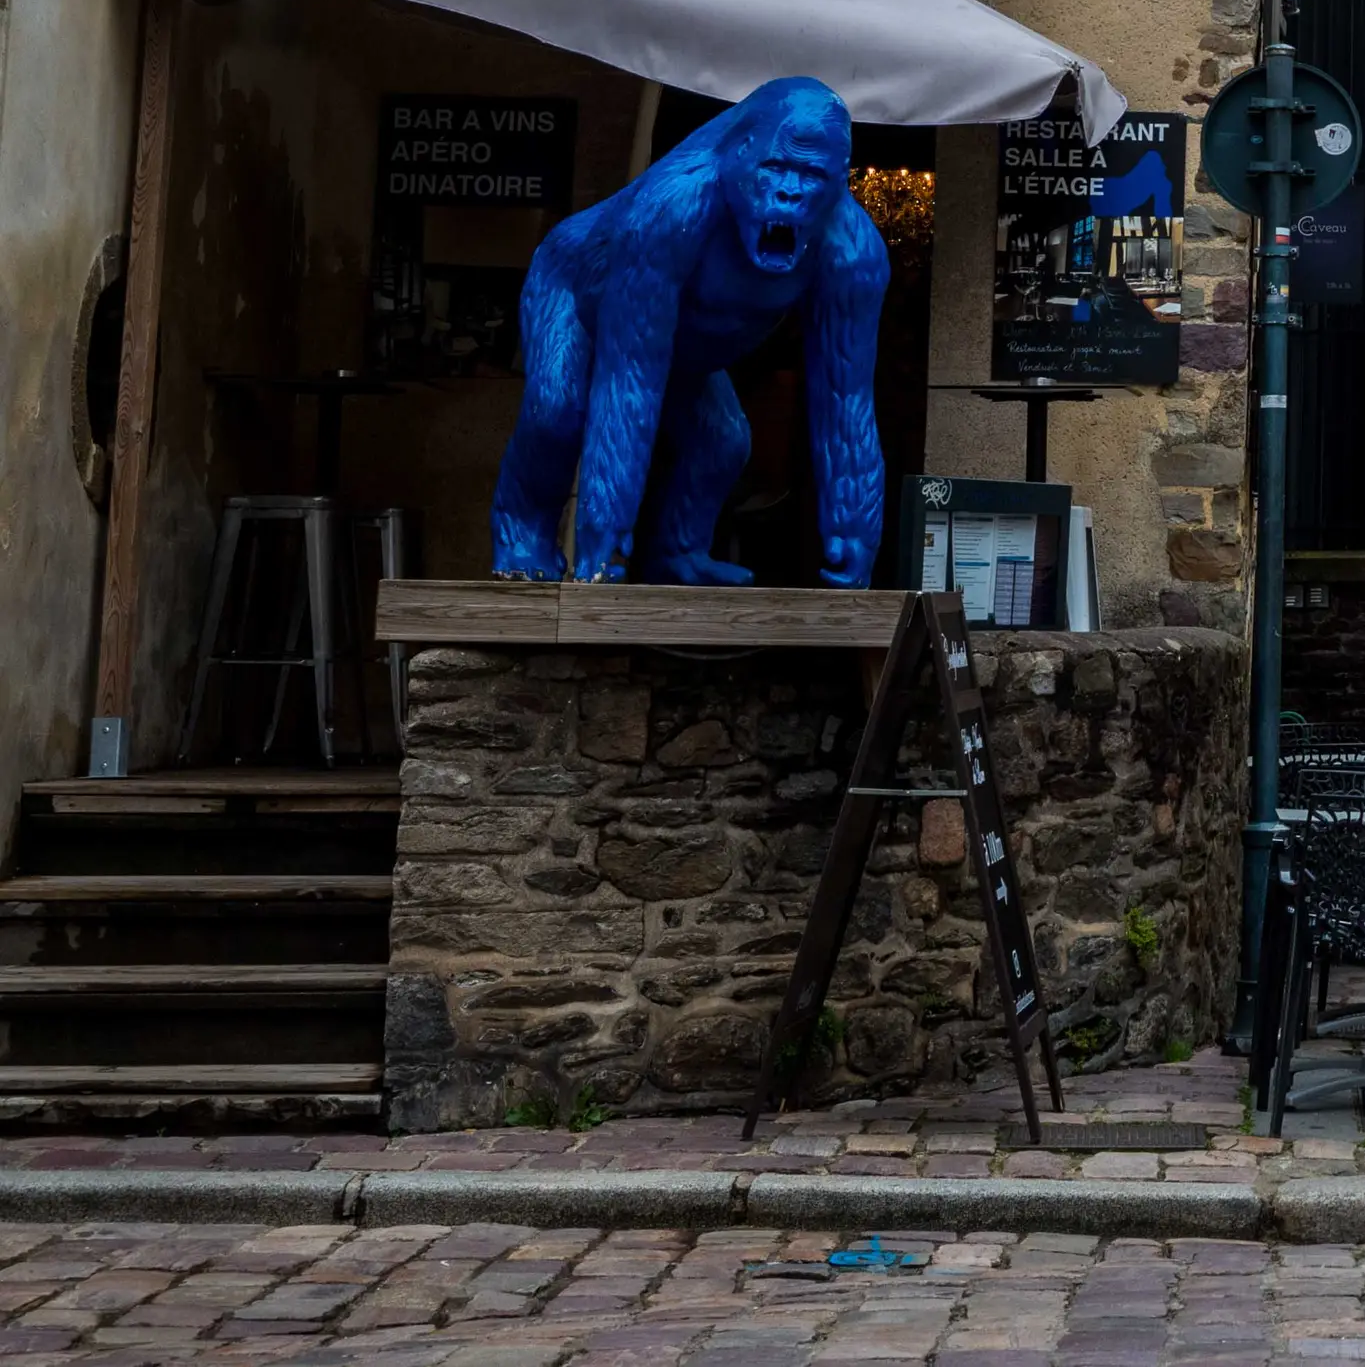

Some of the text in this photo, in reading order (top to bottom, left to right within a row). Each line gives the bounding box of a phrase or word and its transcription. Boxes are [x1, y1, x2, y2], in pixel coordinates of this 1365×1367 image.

[393, 107, 555, 132] BAR A VINS
[1006, 119, 1170, 143] RESTARANT
[391, 136, 492, 163] APÉRO
[1005, 145, 1107, 168] SALLE À
[389, 173, 543, 197] DINATOIRE
[1004, 173, 1104, 196] L'ÉTAGE
